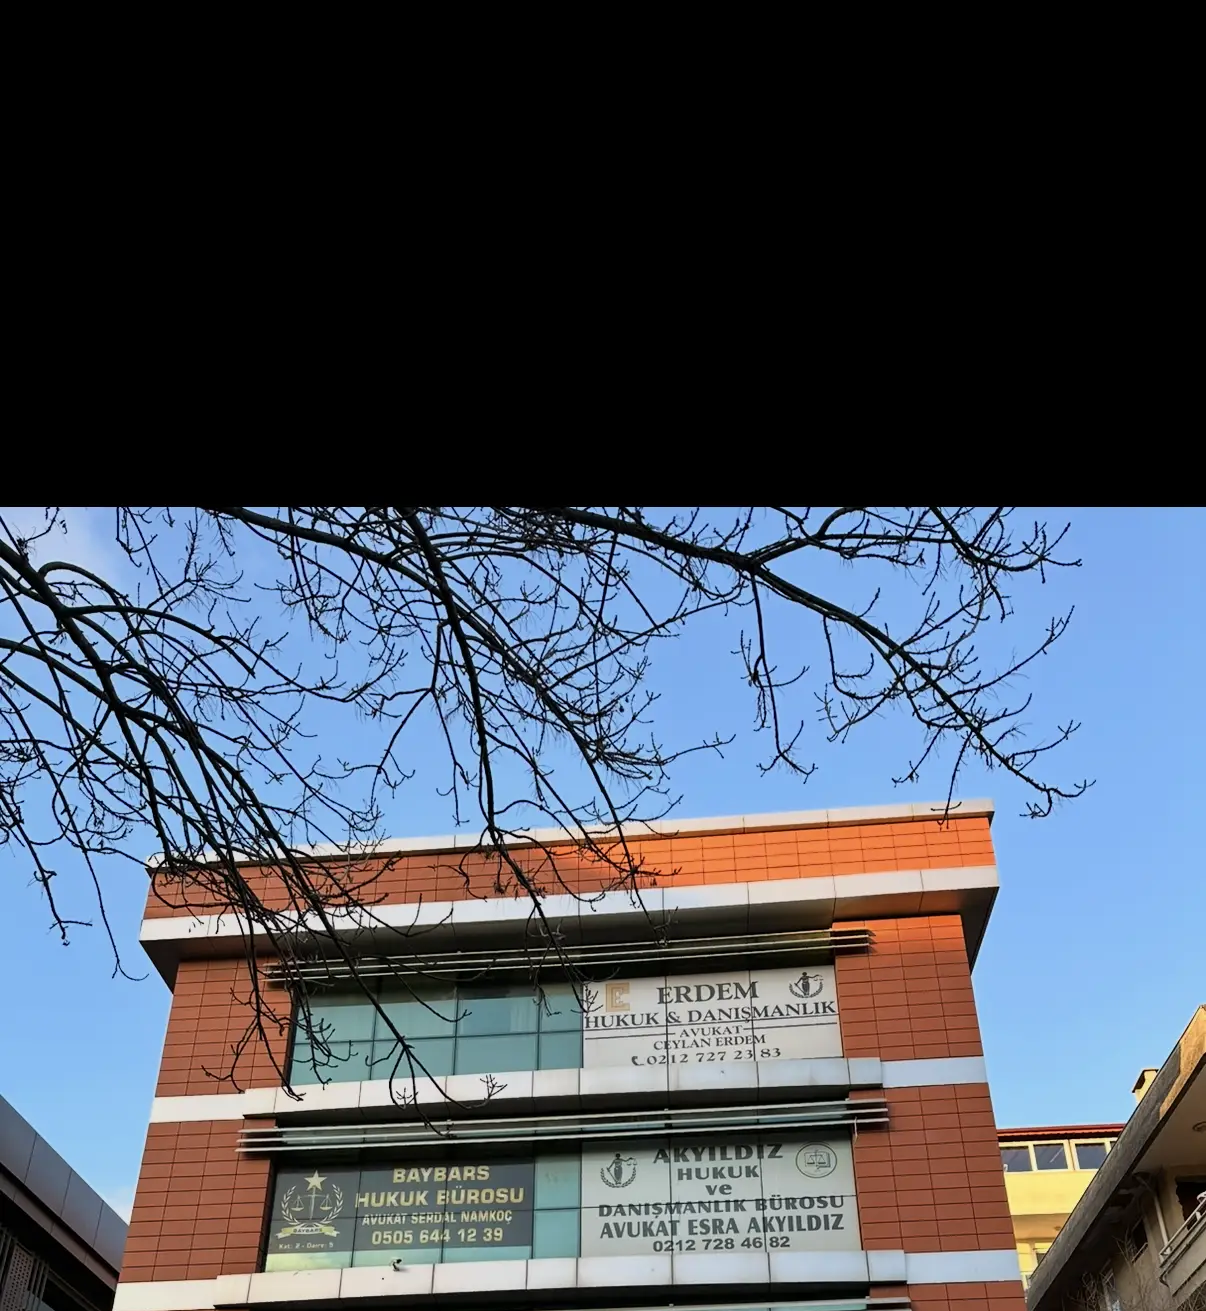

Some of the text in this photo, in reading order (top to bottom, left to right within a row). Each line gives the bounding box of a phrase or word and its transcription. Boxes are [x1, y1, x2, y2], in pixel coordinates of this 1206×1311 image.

[657, 981, 759, 1005] ERDEM
[584, 1001, 835, 1029] HUKUK & DANIŞMANLIK
[679, 1025, 743, 1038] AVUKAT
[653, 1035, 766, 1050] CEYLAN ERDEM
[647, 1048, 781, 1065] 0212 727 23 83
[653, 1143, 783, 1164] AKYILDIZ
[392, 1165, 490, 1183] BAYBARS
[677, 1165, 760, 1181] HUKUK
[355, 1186, 525, 1208] HUKUK BÜROSU
[706, 1184, 733, 1196] ve
[598, 1194, 845, 1218] DANIŞMANLIK BÜROSU
[362, 1209, 513, 1226] AVUKAT SERDAL NAMKOÇ
[600, 1214, 845, 1239] AVUKAT ESRA AKYILDIZ
[371, 1227, 504, 1245] 0505 644 12 39
[653, 1236, 791, 1252] 0212 728 46 82
